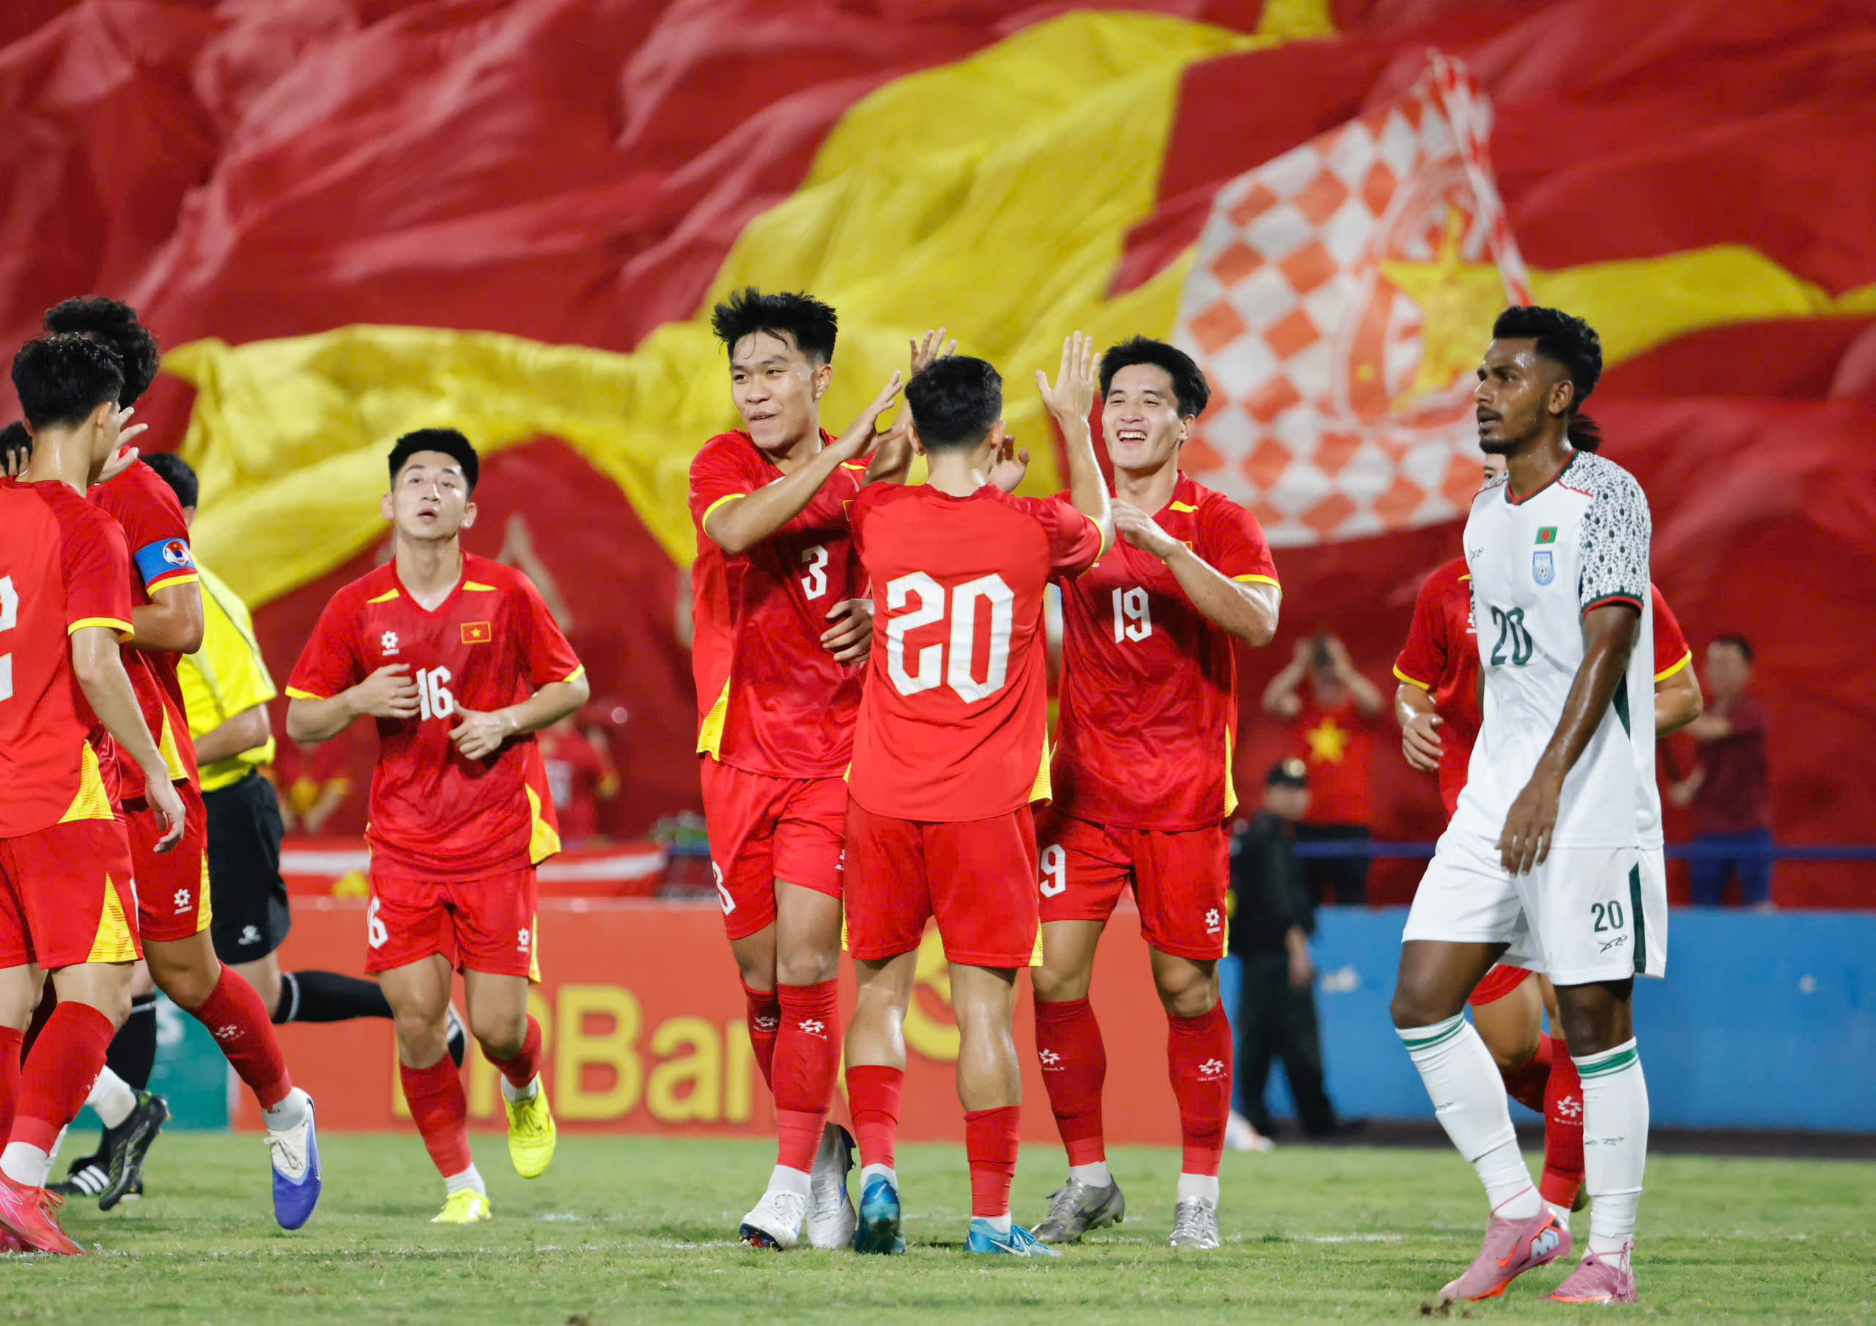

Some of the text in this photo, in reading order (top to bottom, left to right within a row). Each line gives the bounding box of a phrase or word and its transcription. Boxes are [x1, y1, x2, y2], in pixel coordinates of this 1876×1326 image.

[801, 545, 829, 601] 3
[886, 570, 1015, 705] 20
[1112, 586, 1153, 644] 19
[1490, 606, 1533, 666] 20
[416, 665, 454, 721] 16
[1038, 843, 1066, 898] 9
[367, 896, 389, 949] 6
[1591, 900, 1624, 933] 20
